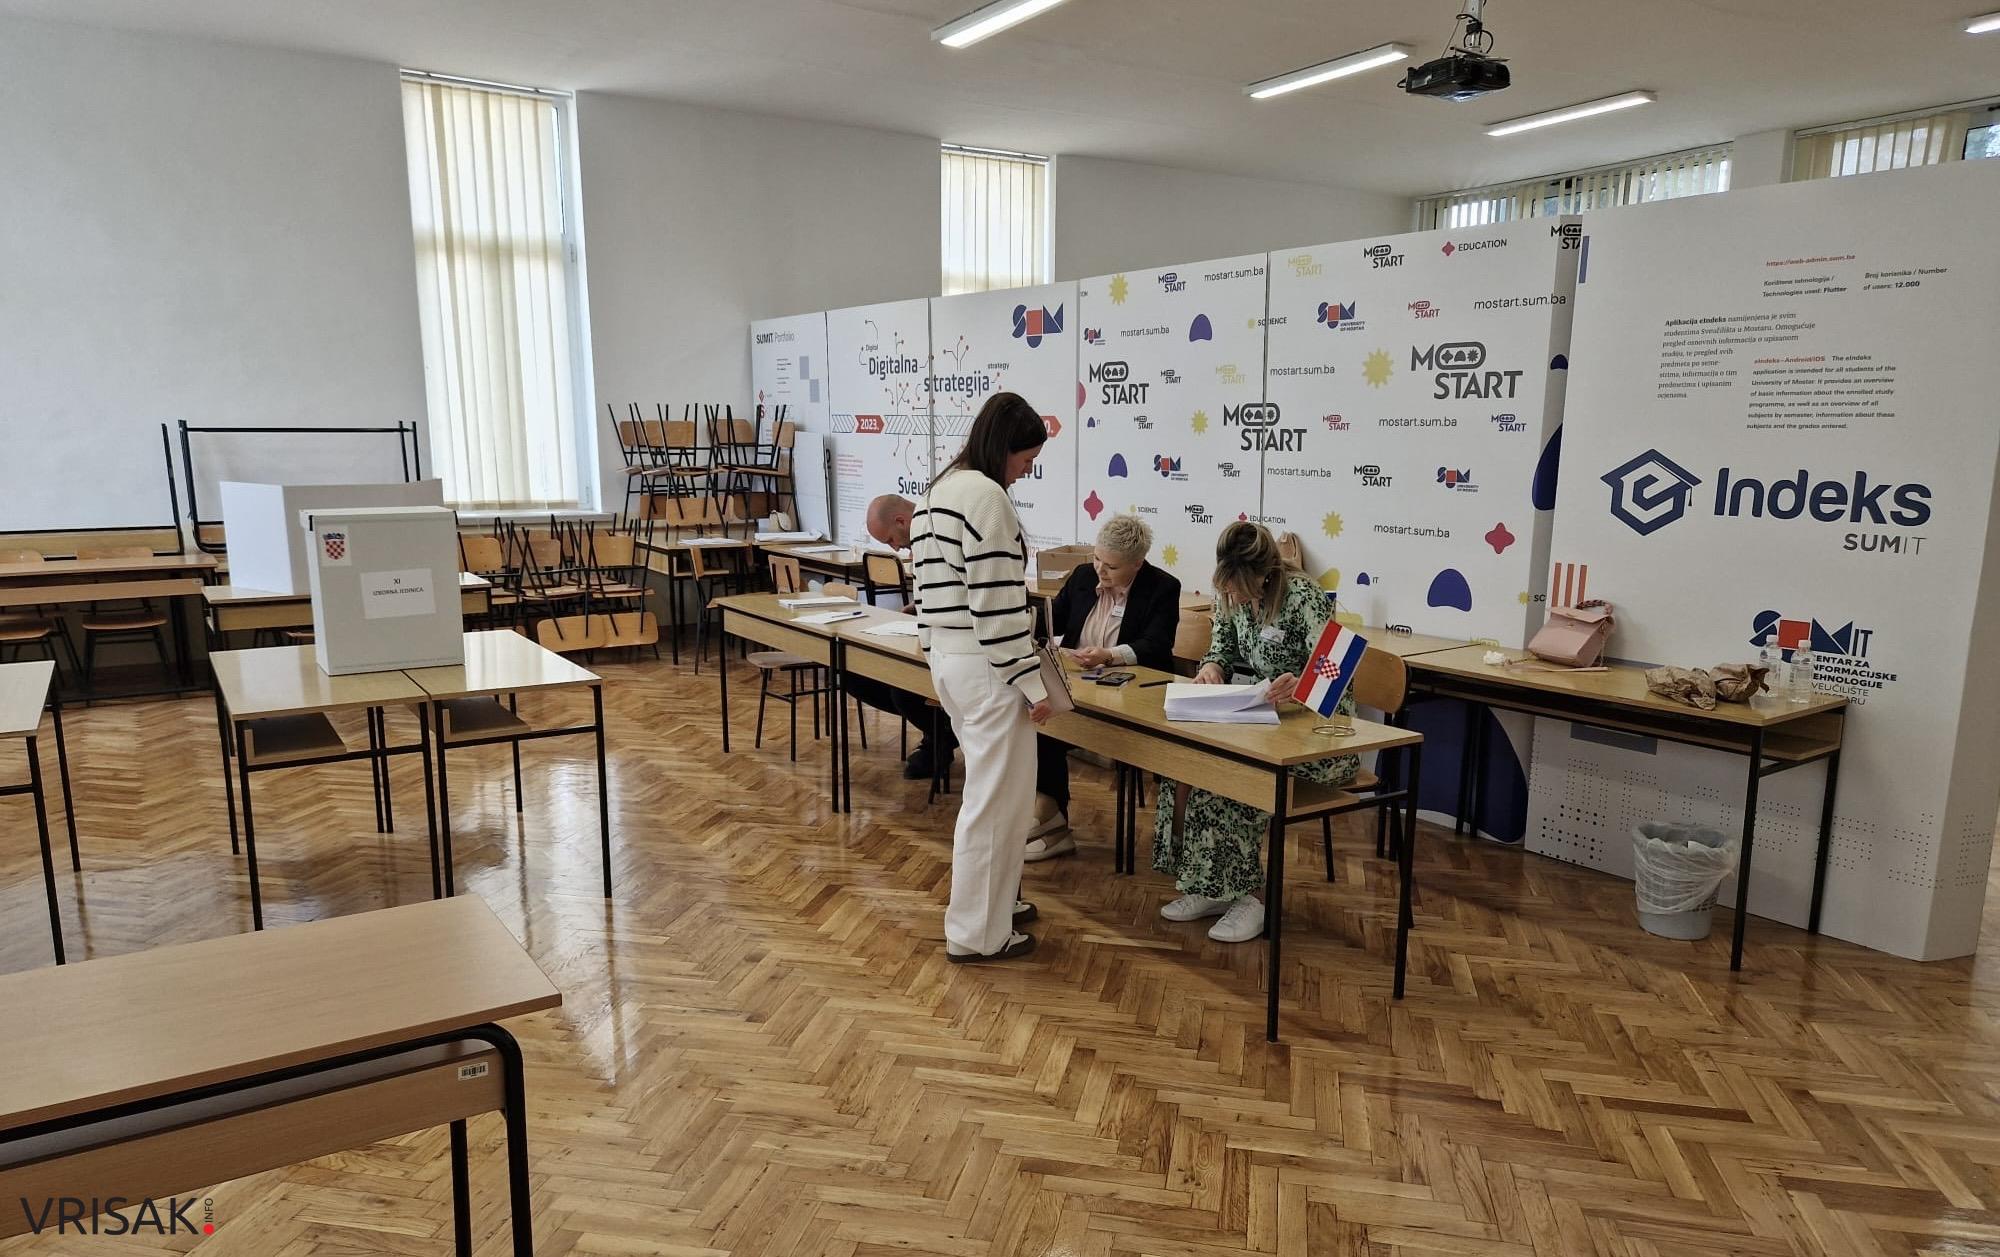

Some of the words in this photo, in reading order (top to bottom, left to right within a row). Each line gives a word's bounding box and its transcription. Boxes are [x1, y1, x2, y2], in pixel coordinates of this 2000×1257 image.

[1458, 239, 1507, 251] EDUCATION
[1373, 255, 1404, 268] START
[1204, 266, 1264, 282] mostart.sum.ba
[1164, 281, 1186, 292] START
[1895, 280, 1920, 288] 12.000
[1474, 293, 1567, 310] mostart.sum.ba
[1414, 308, 1440, 319] START
[1257, 316, 1288, 326] SCIENCE
[1120, 325, 1170, 337] mostart.sum.ba
[756, 333, 773, 344] SUMIT
[869, 354, 918, 380] Digitalna
[987, 361, 1010, 371] strategy
[1270, 365, 1335, 376] mostart.sum.ba
[924, 370, 990, 398] strategija
[1165, 376, 1181, 385] START
[1433, 370, 1523, 400] START
[1102, 383, 1149, 405] START
[860, 419, 880, 431] 2023.
[1138, 422, 1154, 430] START
[1328, 422, 1350, 431] START
[1378, 415, 1457, 428] mostart.sum.ba
[1498, 422, 1527, 432] START
[1240, 428, 1307, 452] START
[1223, 469, 1240, 478] START
[1267, 466, 1332, 479] mostart.sum.ba
[1362, 475, 1392, 487] START
[1714, 467, 1932, 527] Indeks
[1015, 500, 1034, 509] Mostar
[1137, 506, 1158, 514] SCIENCE
[1191, 513, 1213, 525] START
[1249, 514, 1287, 524] EDUCATION
[1374, 523, 1450, 539] mostart.sum.ba
[1843, 533, 1927, 555] SUMIT
[1373, 576, 1379, 584] IT
[1814, 655, 1852, 666] ENTAR
[1854, 660, 1870, 668] ZA
[1813, 664, 1897, 682] NFORMACIJSKE
[1813, 673, 1883, 689] EHNOLOGIJE
[1811, 681, 1869, 697] VEUČILIŠTE
